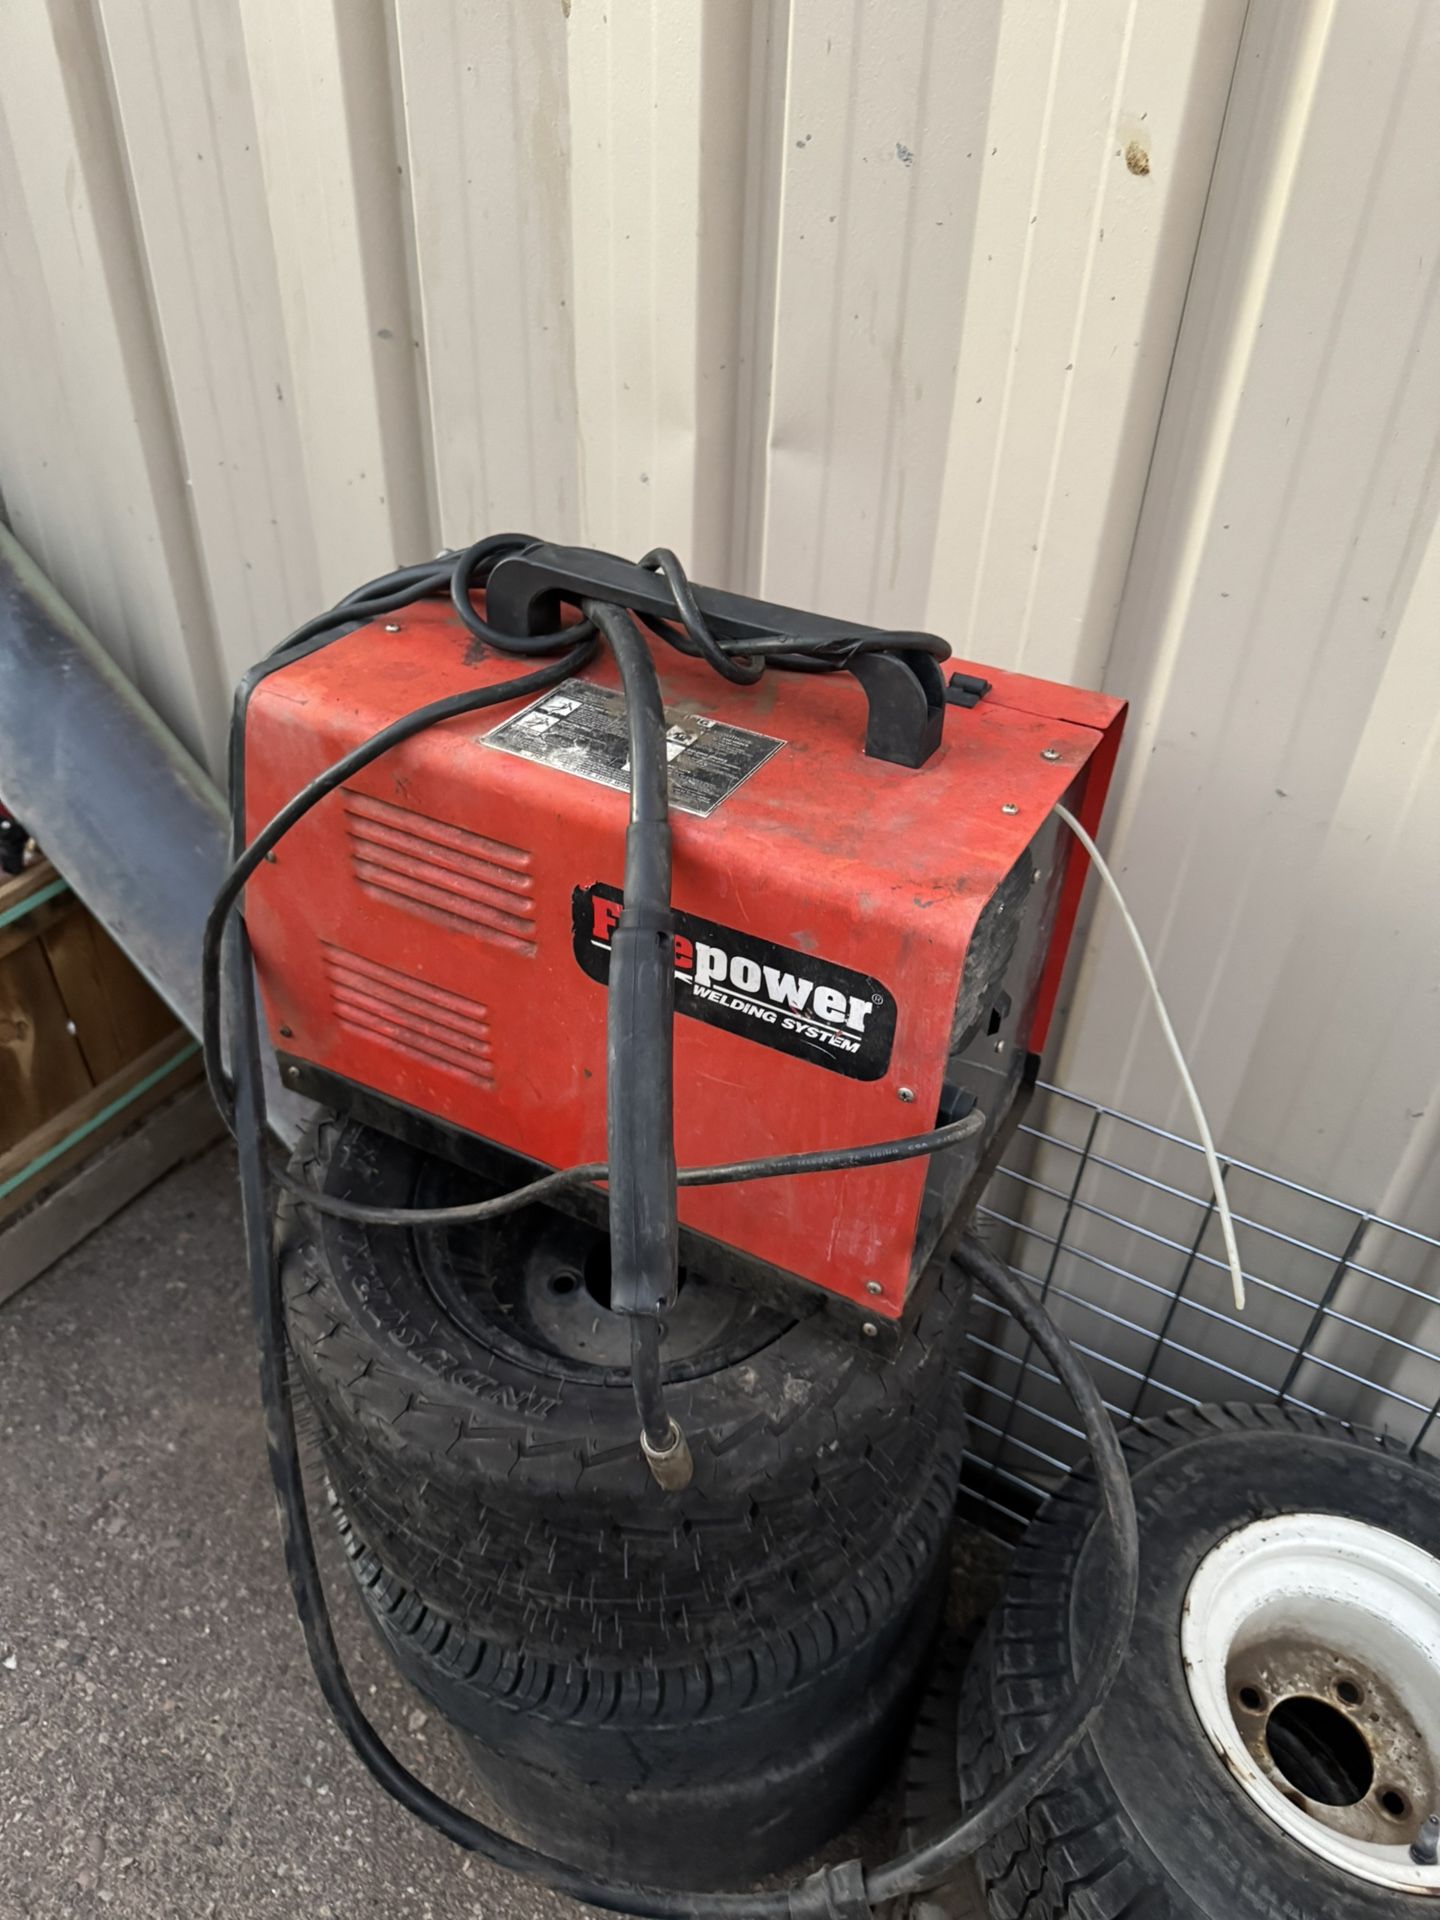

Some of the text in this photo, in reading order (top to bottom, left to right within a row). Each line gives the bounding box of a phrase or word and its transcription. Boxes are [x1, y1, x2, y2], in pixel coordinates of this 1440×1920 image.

[592, 896, 872, 1032] Fepower
[692, 984, 861, 1054] WELDING SYSTEM
